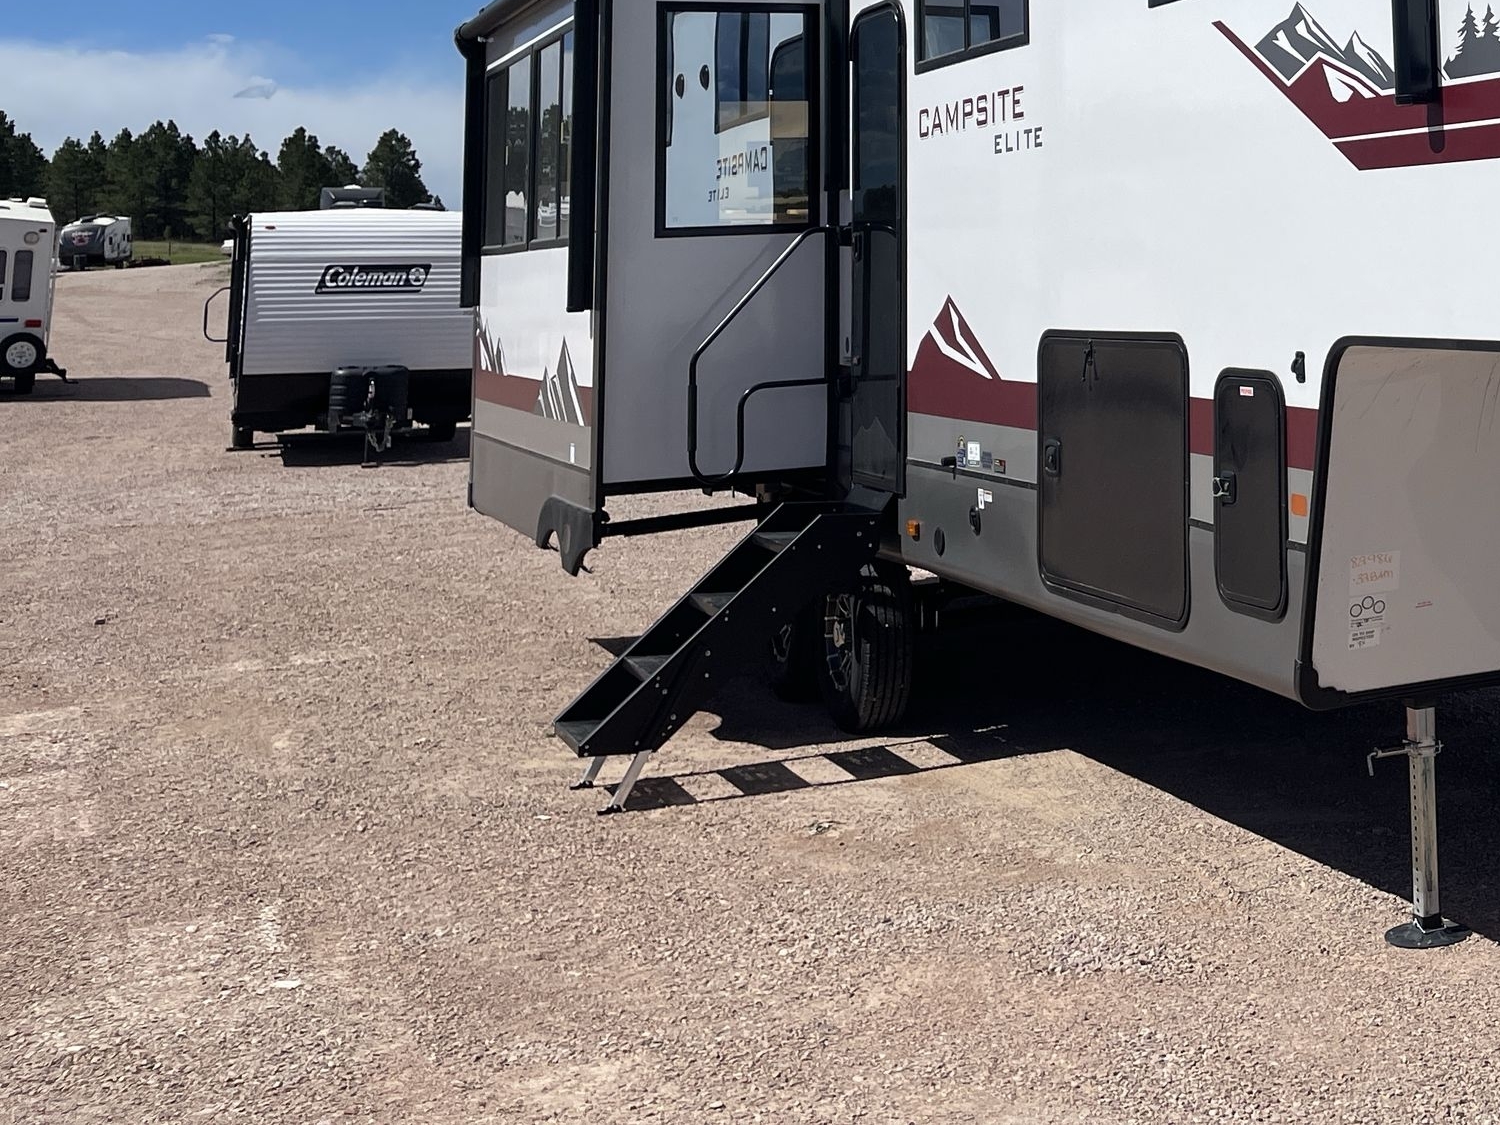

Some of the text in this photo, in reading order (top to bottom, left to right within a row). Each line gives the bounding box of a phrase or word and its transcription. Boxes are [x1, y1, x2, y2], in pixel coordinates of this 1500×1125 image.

[919, 85, 1024, 139] CAMPSITE
[994, 126, 1043, 154] ELITE
[325, 266, 407, 287] Coleman
